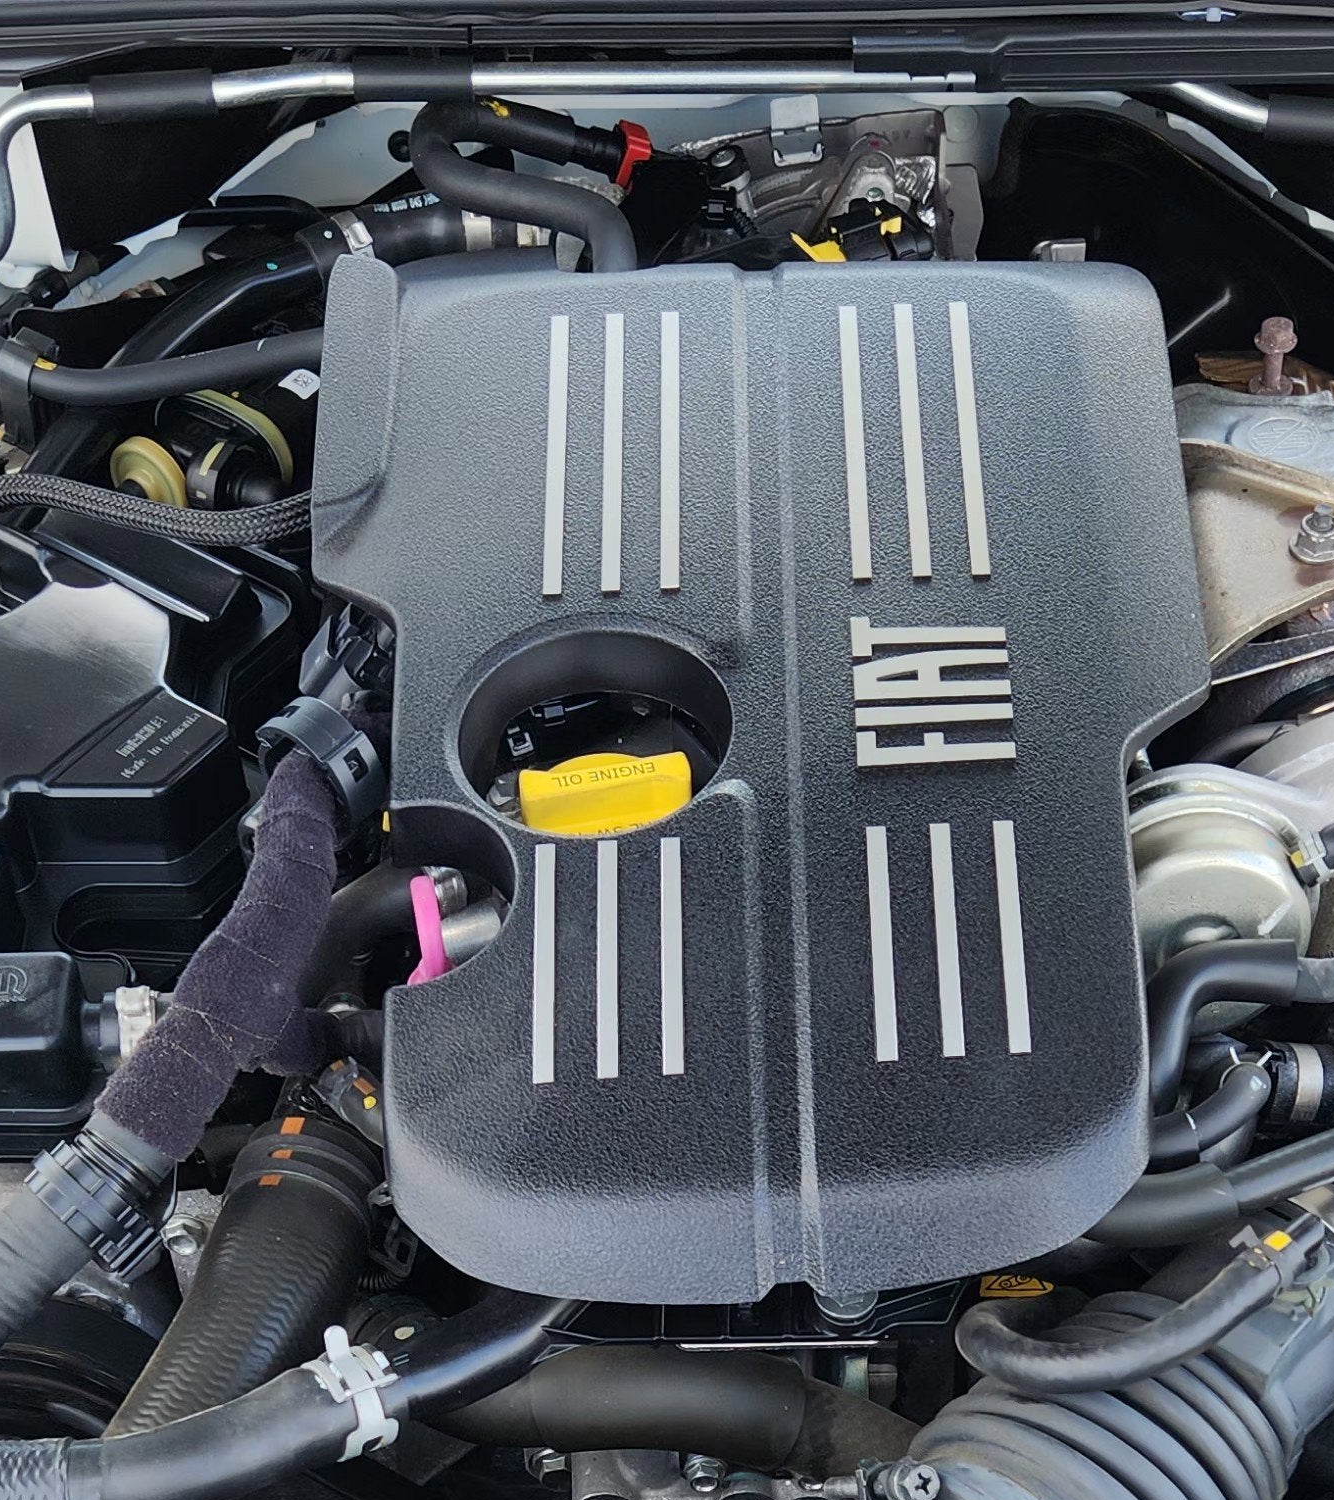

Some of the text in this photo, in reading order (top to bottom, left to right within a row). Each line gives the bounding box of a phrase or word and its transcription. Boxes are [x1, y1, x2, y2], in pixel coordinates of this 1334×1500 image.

[850, 616, 1016, 767] FIAT
[551, 762, 656, 788] ENGINE OIL
